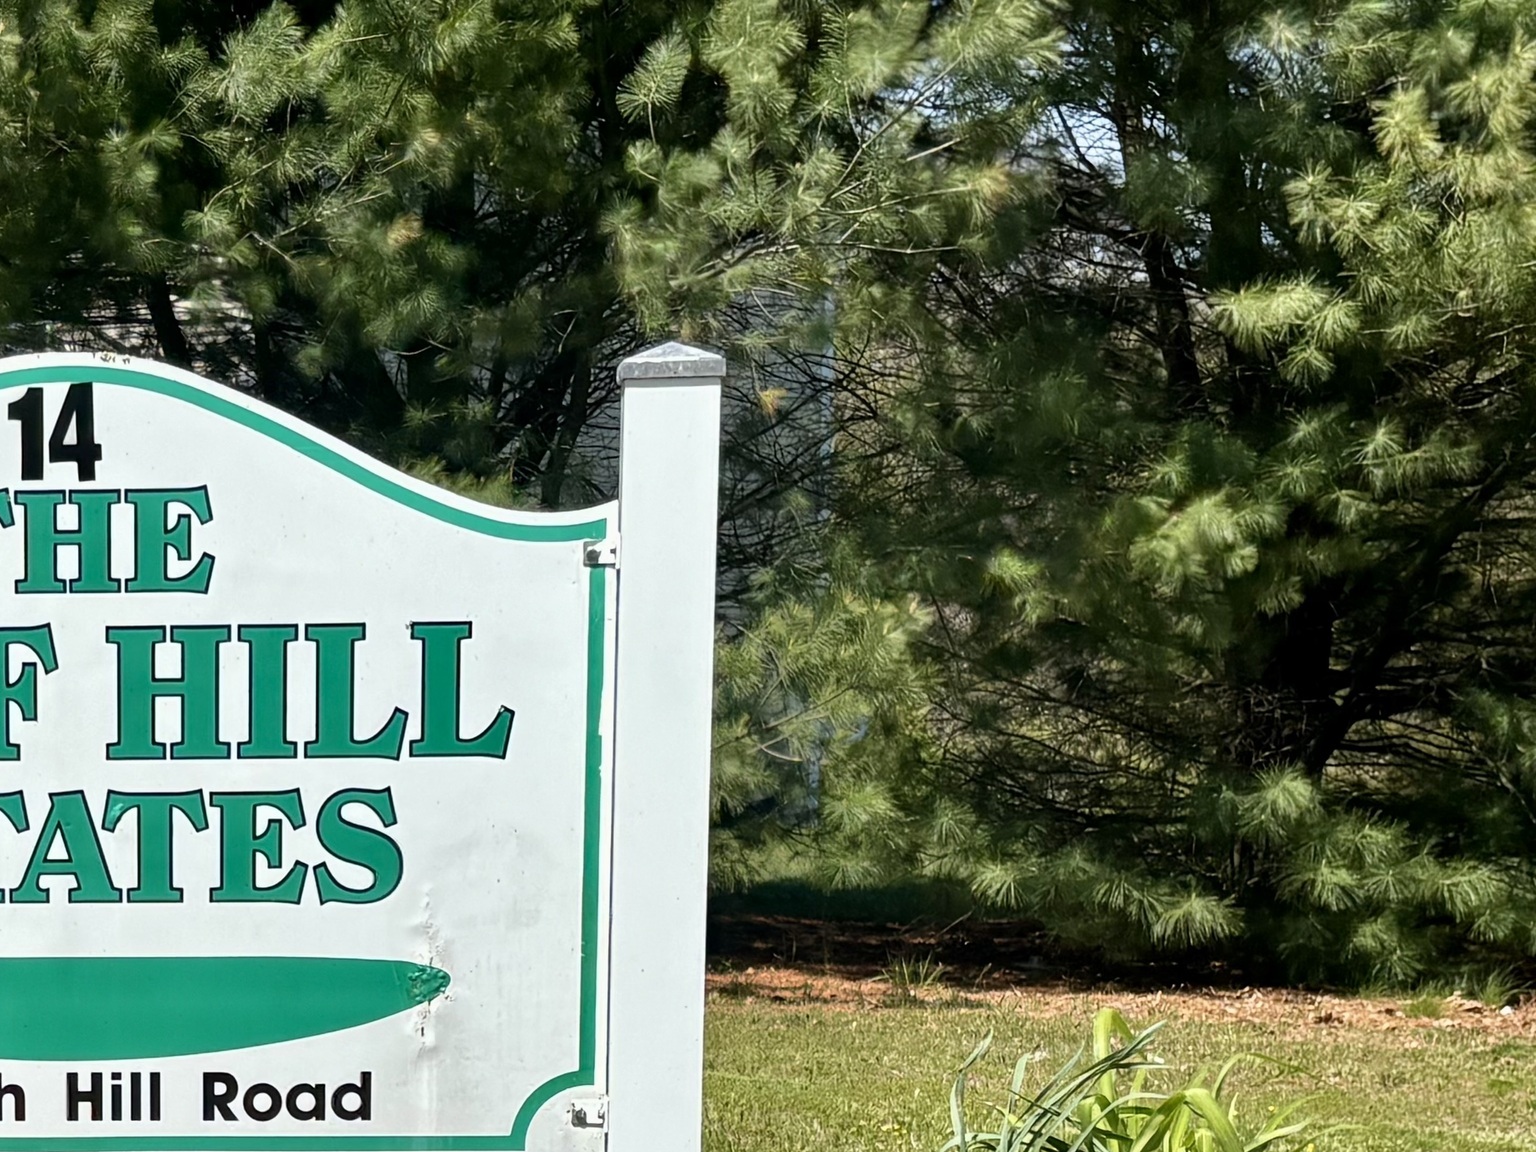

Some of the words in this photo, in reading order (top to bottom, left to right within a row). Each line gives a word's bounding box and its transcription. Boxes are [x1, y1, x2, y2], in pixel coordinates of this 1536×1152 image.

[8, 382, 102, 481] 14
[105, 621, 515, 761] HILL
[67, 1071, 161, 1121] Hill
[203, 1071, 372, 1121] Road
